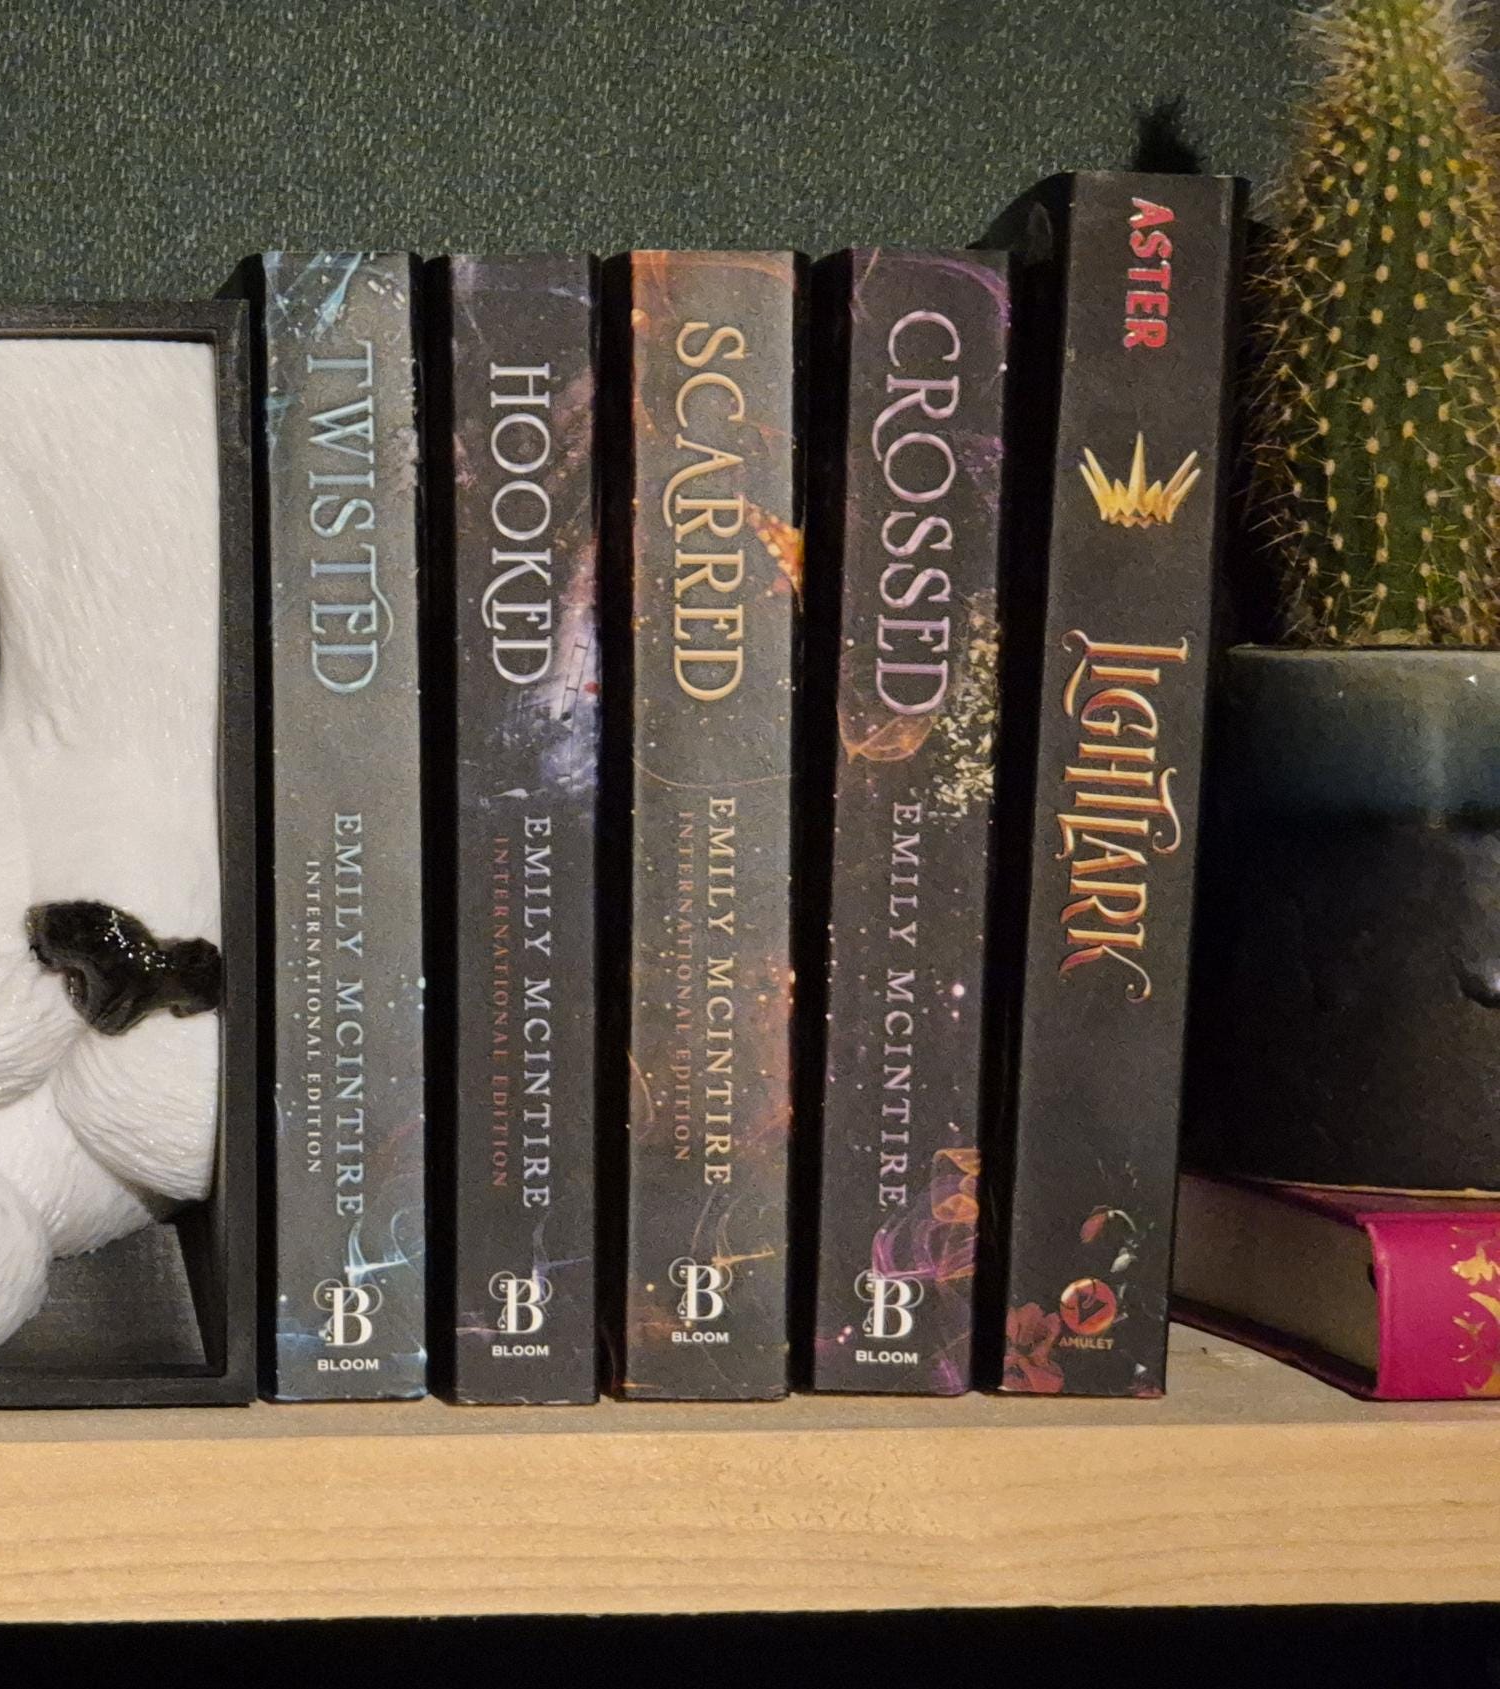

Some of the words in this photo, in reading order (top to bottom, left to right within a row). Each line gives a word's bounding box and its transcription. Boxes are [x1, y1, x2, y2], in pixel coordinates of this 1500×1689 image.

[1124, 198, 1177, 350] ASTER
[307, 340, 394, 694] TWISTED
[481, 362, 552, 685] HOOKED
[663, 321, 750, 701] SCARRED
[872, 311, 961, 715] CROSSED
[334, 812, 363, 958] EMILY
[523, 816, 552, 958] EMILY
[707, 796, 737, 936] EMILY
[886, 801, 922, 947] EMILY
[1055, 629, 1189, 1001] LIGHTLARK
[306, 861, 321, 1061] INTERNATIONAL
[492, 836, 510, 1058] INTERNATIONAL
[675, 811, 694, 1044] INTERNATIONAL
[306, 1072, 321, 1174] EDITION
[335, 980, 364, 1217] MCINTIRE
[491, 1075, 509, 1189] EDITION
[523, 979, 552, 1208] MCINTIRE
[673, 1048, 691, 1162] EDITION
[704, 957, 735, 1185] MCINTIRE
[878, 969, 916, 1206] MCINTIRE
[317, 1358, 379, 1371] BLOOM
[492, 1345, 549, 1357] BLOOM
[671, 1331, 729, 1343] BLOOM
[855, 1350, 918, 1365] BLOOM
[1058, 1336, 1114, 1350] AMULET
